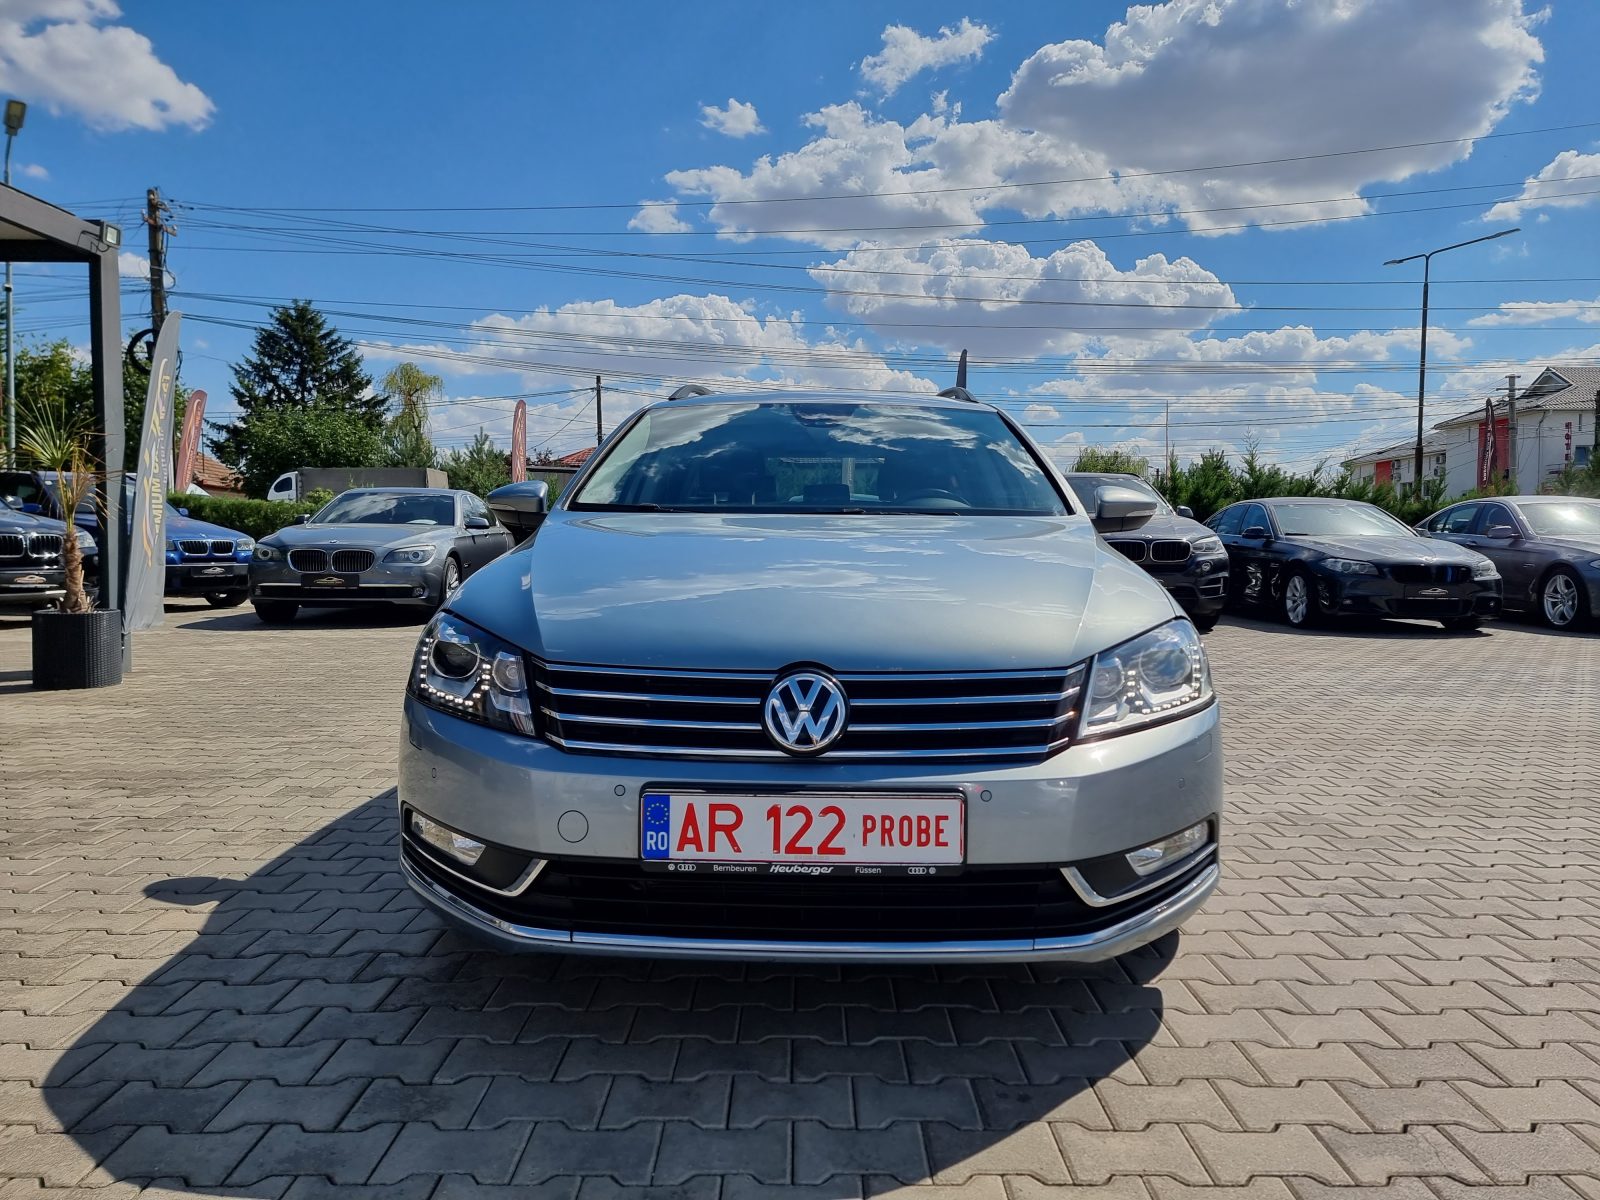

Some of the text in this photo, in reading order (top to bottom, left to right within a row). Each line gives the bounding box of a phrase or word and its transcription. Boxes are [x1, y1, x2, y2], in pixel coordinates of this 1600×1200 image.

[765, 673, 846, 751] VW
[646, 831, 668, 851] RO
[676, 803, 950, 855] AR 122 PROBE
[713, 864, 883, 876] Bernbeuren Heuberger Füssen
